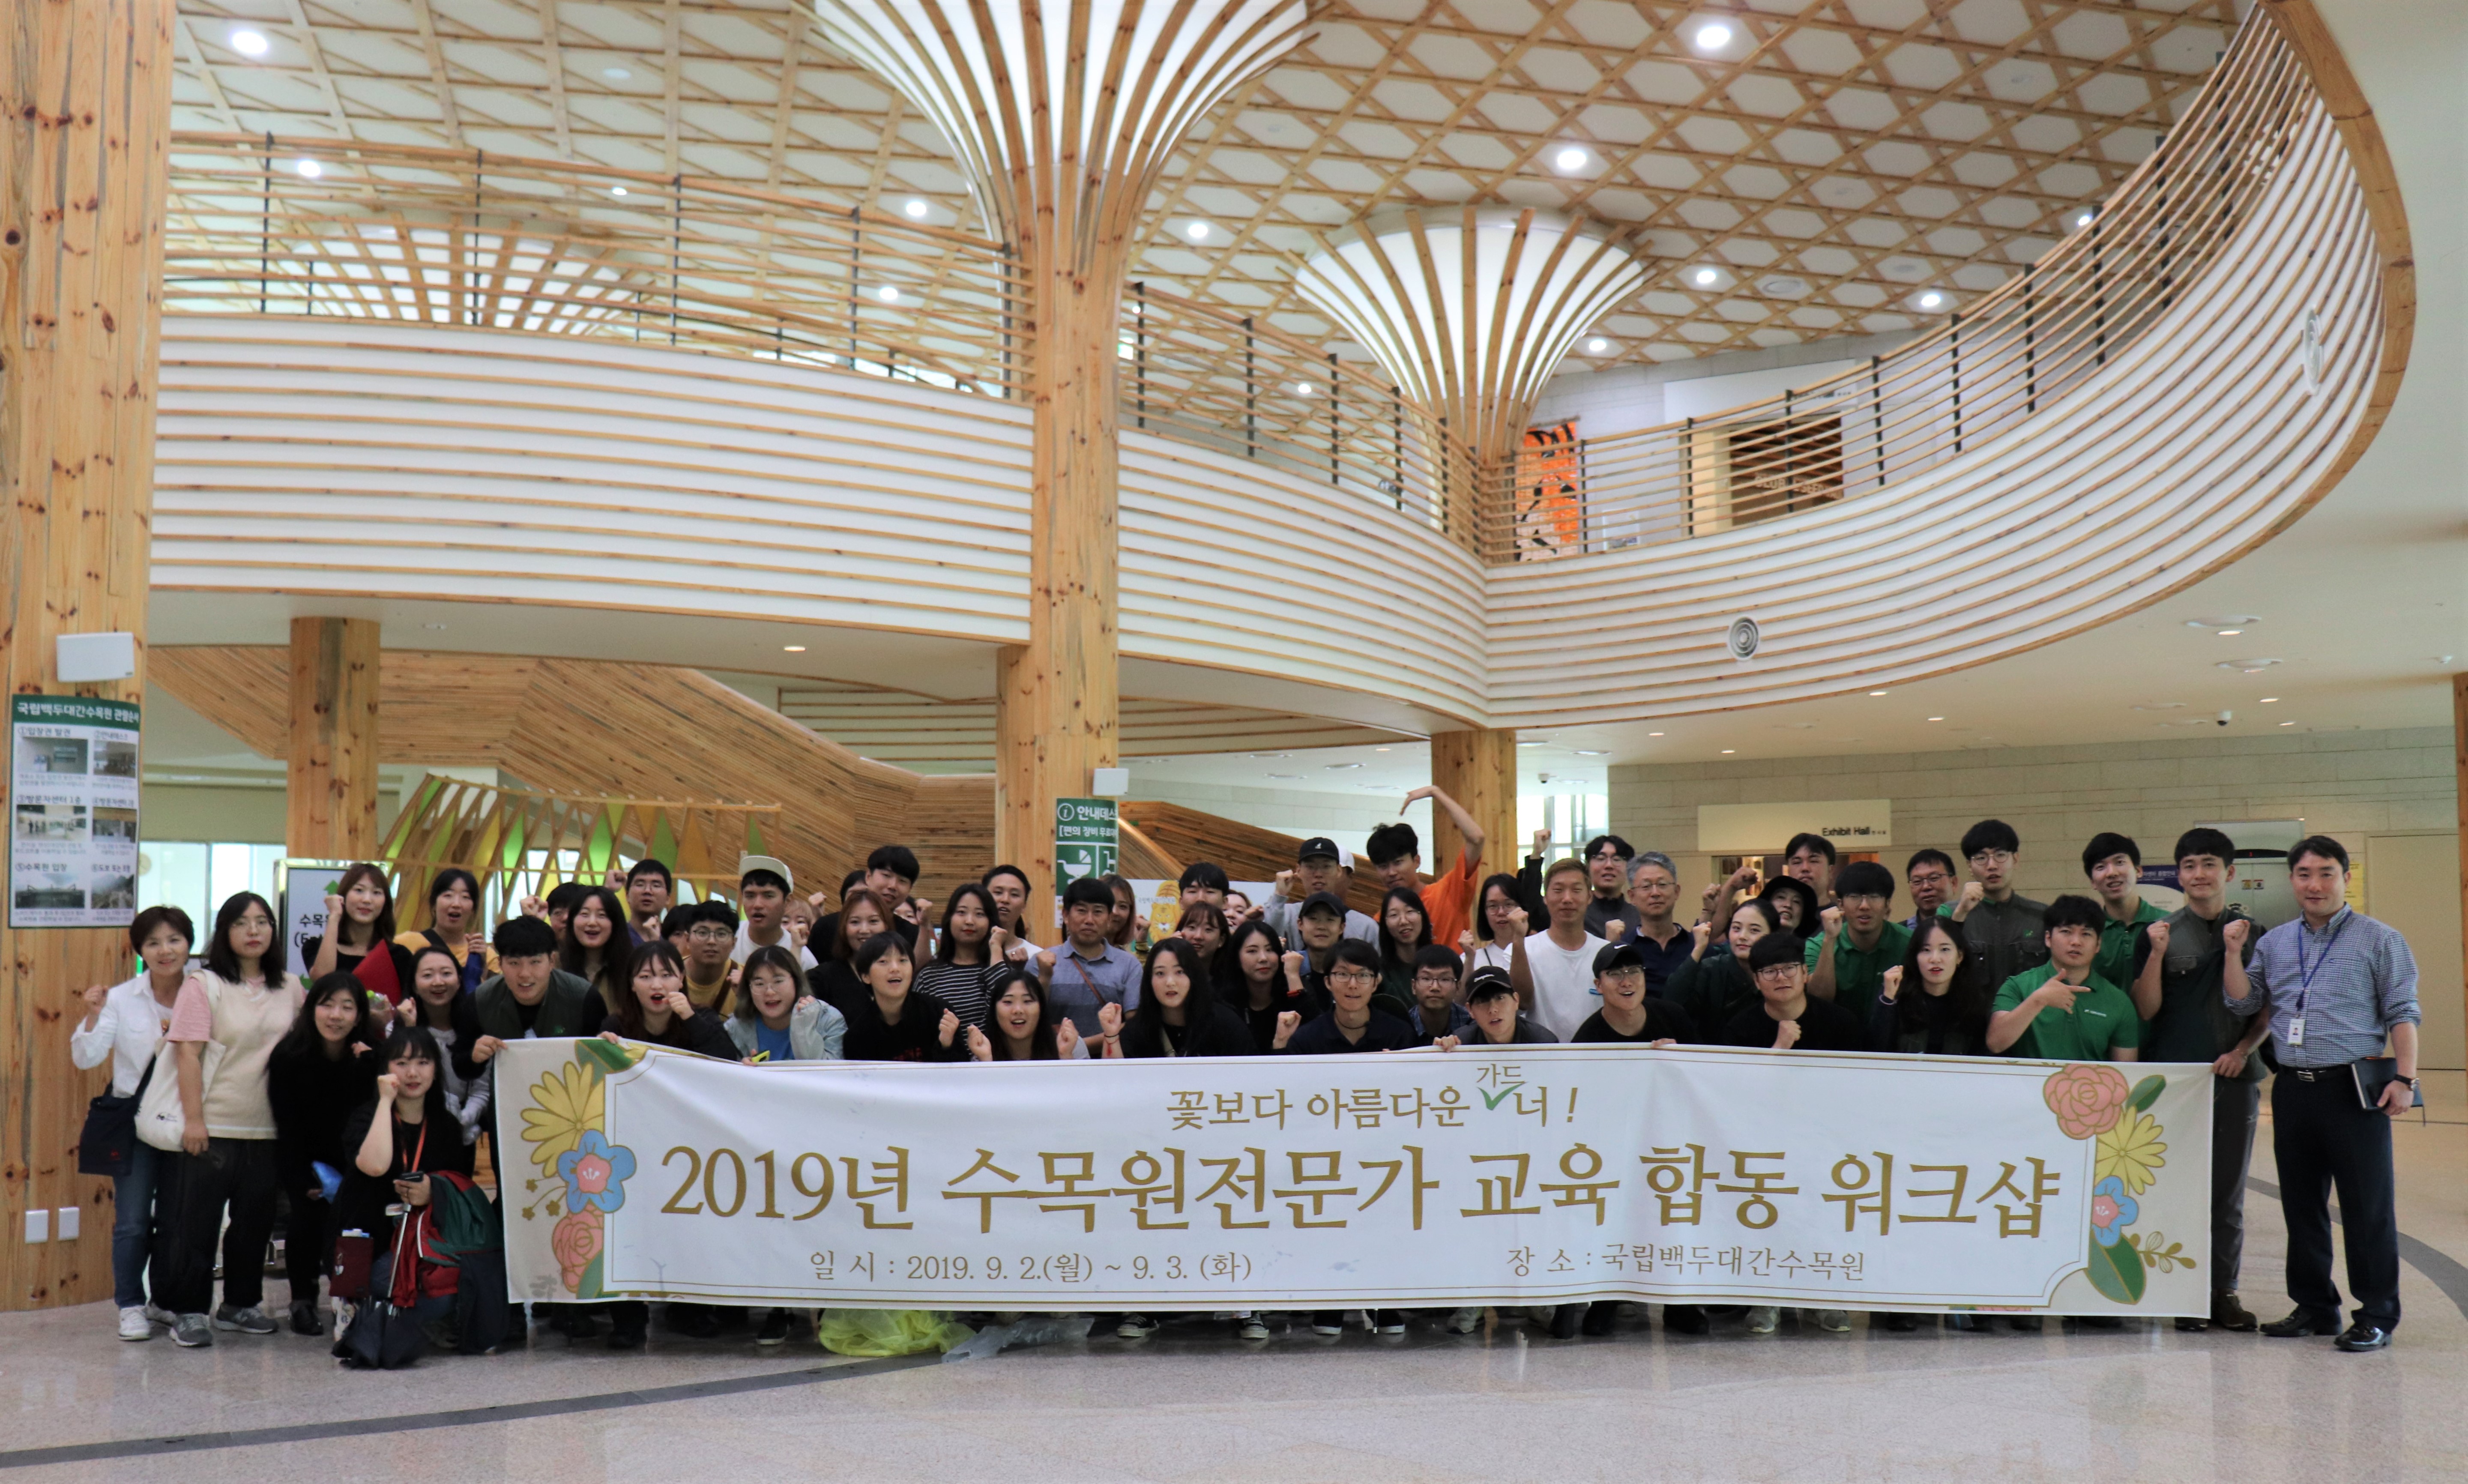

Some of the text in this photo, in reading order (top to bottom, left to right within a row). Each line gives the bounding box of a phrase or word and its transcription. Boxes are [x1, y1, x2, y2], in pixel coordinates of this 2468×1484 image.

[17, 702, 112, 721] 국립백두대간수목원
[1083, 826, 1098, 837] 장비
[1822, 827, 1851, 836] Exhibit
[1853, 826, 1870, 835] Hall
[1475, 1062, 1525, 1089] 가드
[1166, 1087, 1294, 1131] 꽃보다
[1306, 1084, 1472, 1130] 아름다운
[1514, 1085, 1549, 1127] 너
[660, 1141, 2061, 1239] 2019년 수목원전문가 교육 합동 워크샵
[906, 1255, 975, 1280] 2019.
[985, 1255, 1008, 1279] 9.
[1132, 1255, 1155, 1279] 9.
[1165, 1254, 1188, 1279] 3.
[1199, 1251, 1252, 1280] (화)
[1600, 1242, 1866, 1282] 국립백두대간수목원
